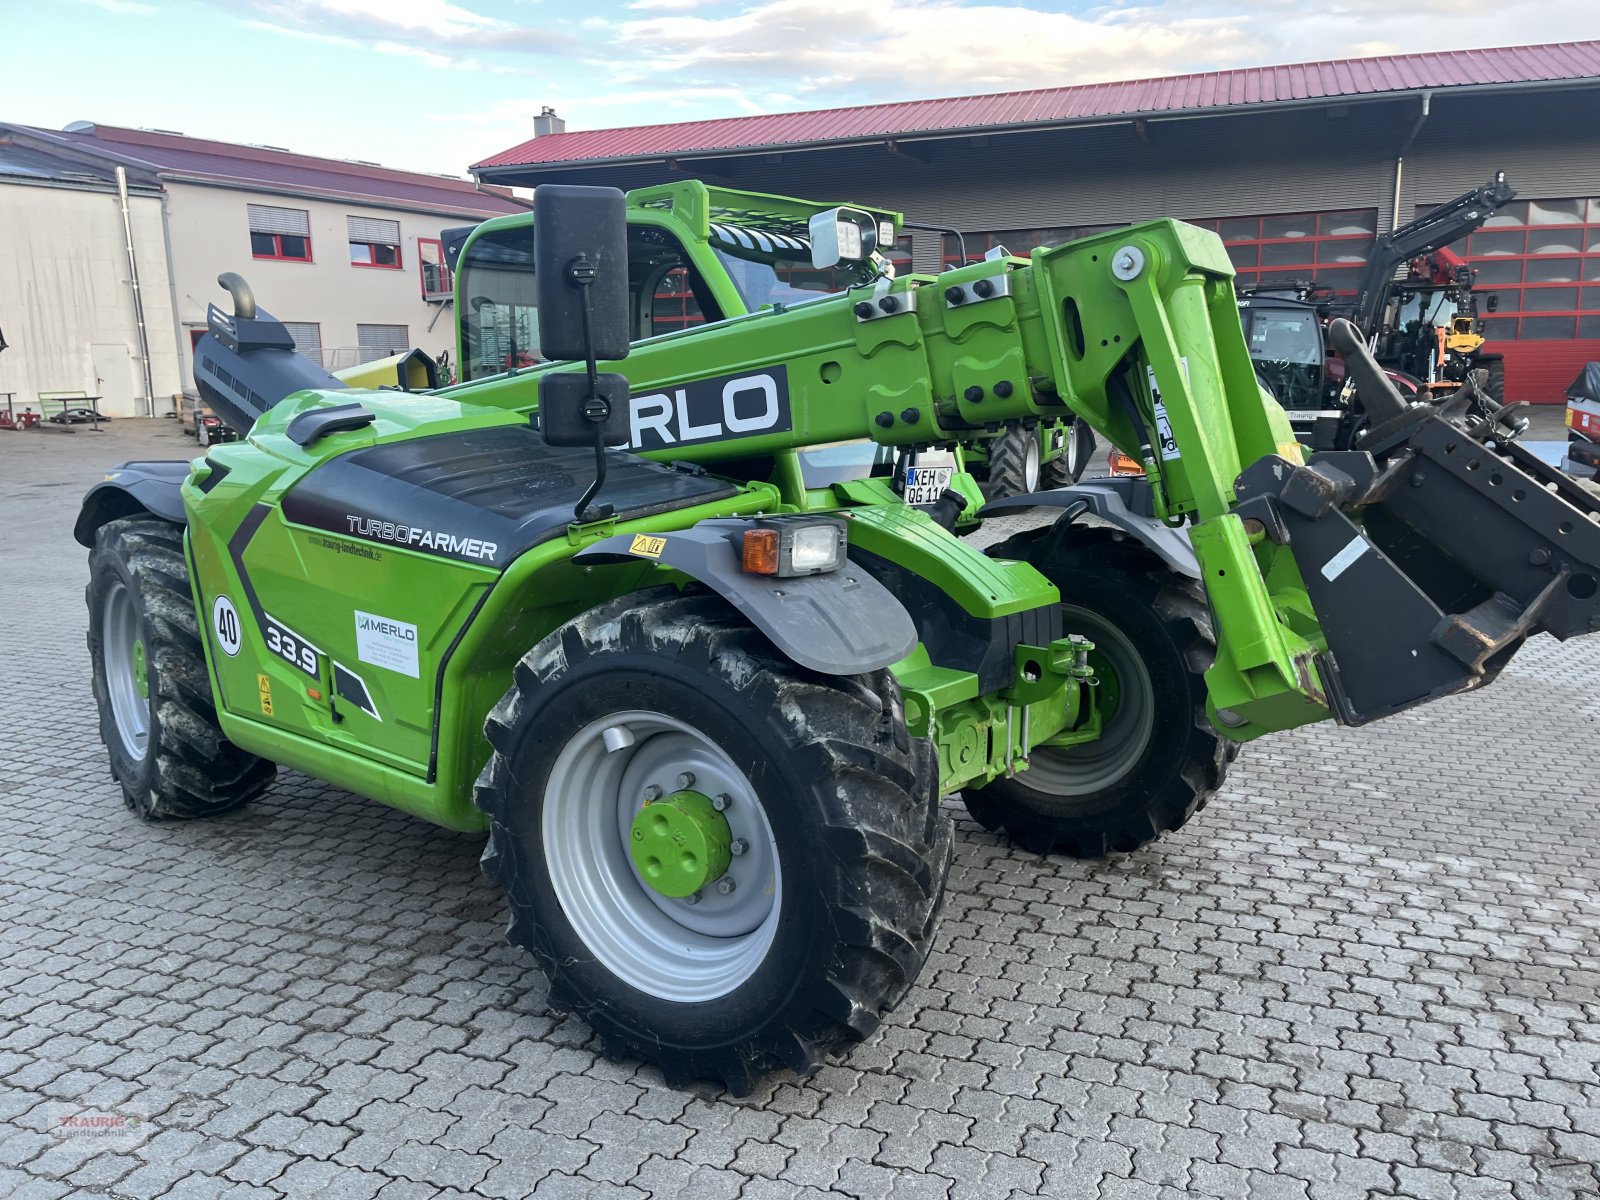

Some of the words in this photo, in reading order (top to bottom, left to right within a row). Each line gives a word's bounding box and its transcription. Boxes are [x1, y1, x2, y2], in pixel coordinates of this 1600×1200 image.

[609, 374, 779, 450] RLO
[908, 488, 923, 503] QG
[914, 470, 936, 486] KEH
[346, 515, 498, 560] TURBOFARMER
[219, 607, 237, 645] 40
[370, 619, 415, 641] MERLO
[267, 626, 317, 675] 33.9
